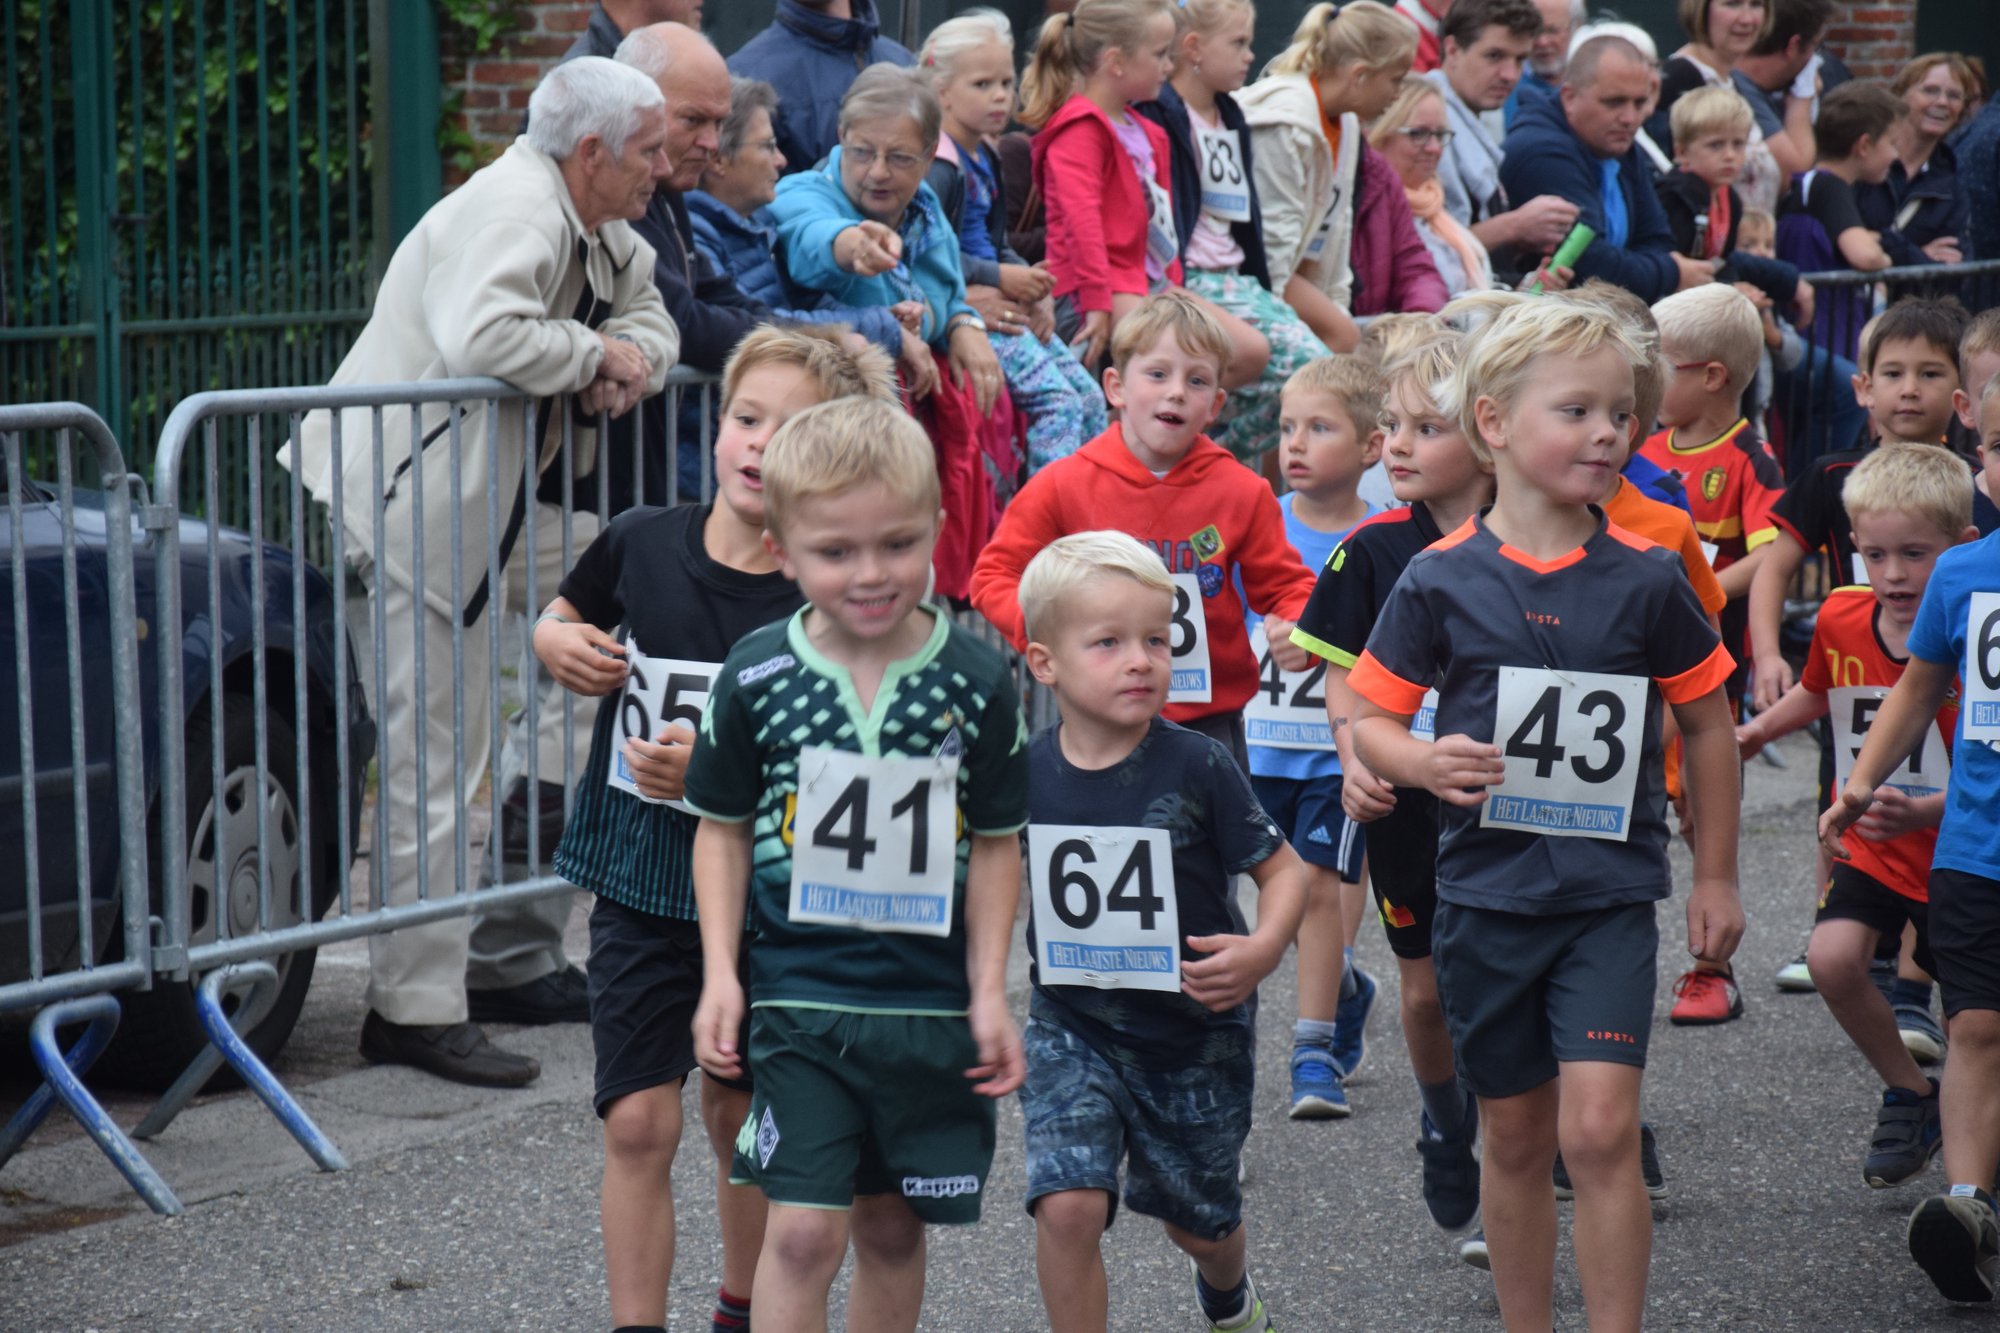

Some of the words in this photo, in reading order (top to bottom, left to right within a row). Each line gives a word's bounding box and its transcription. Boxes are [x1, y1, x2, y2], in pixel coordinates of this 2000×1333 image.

[1978, 607, 2000, 690] 6
[622, 661, 711, 745] 65
[1417, 708, 1436, 731] HE
[1505, 685, 1626, 784] 43
[812, 776, 932, 876] 41
[1495, 797, 1521, 820] HET
[1520, 800, 1573, 827] LAATSTE
[1571, 805, 1618, 831] NIEUWS
[806, 884, 834, 914] HET
[833, 889, 889, 920] LAATSTE
[889, 894, 939, 922] NIEUWS
[1049, 838, 1165, 931] 64
[1052, 943, 1076, 966] HET
[1074, 945, 1123, 970] LAATSTE
[1121, 947, 1169, 971] NIEUWS
[1586, 1030, 1635, 1044] KIPSTA
[903, 1175, 979, 1198] Kappa
